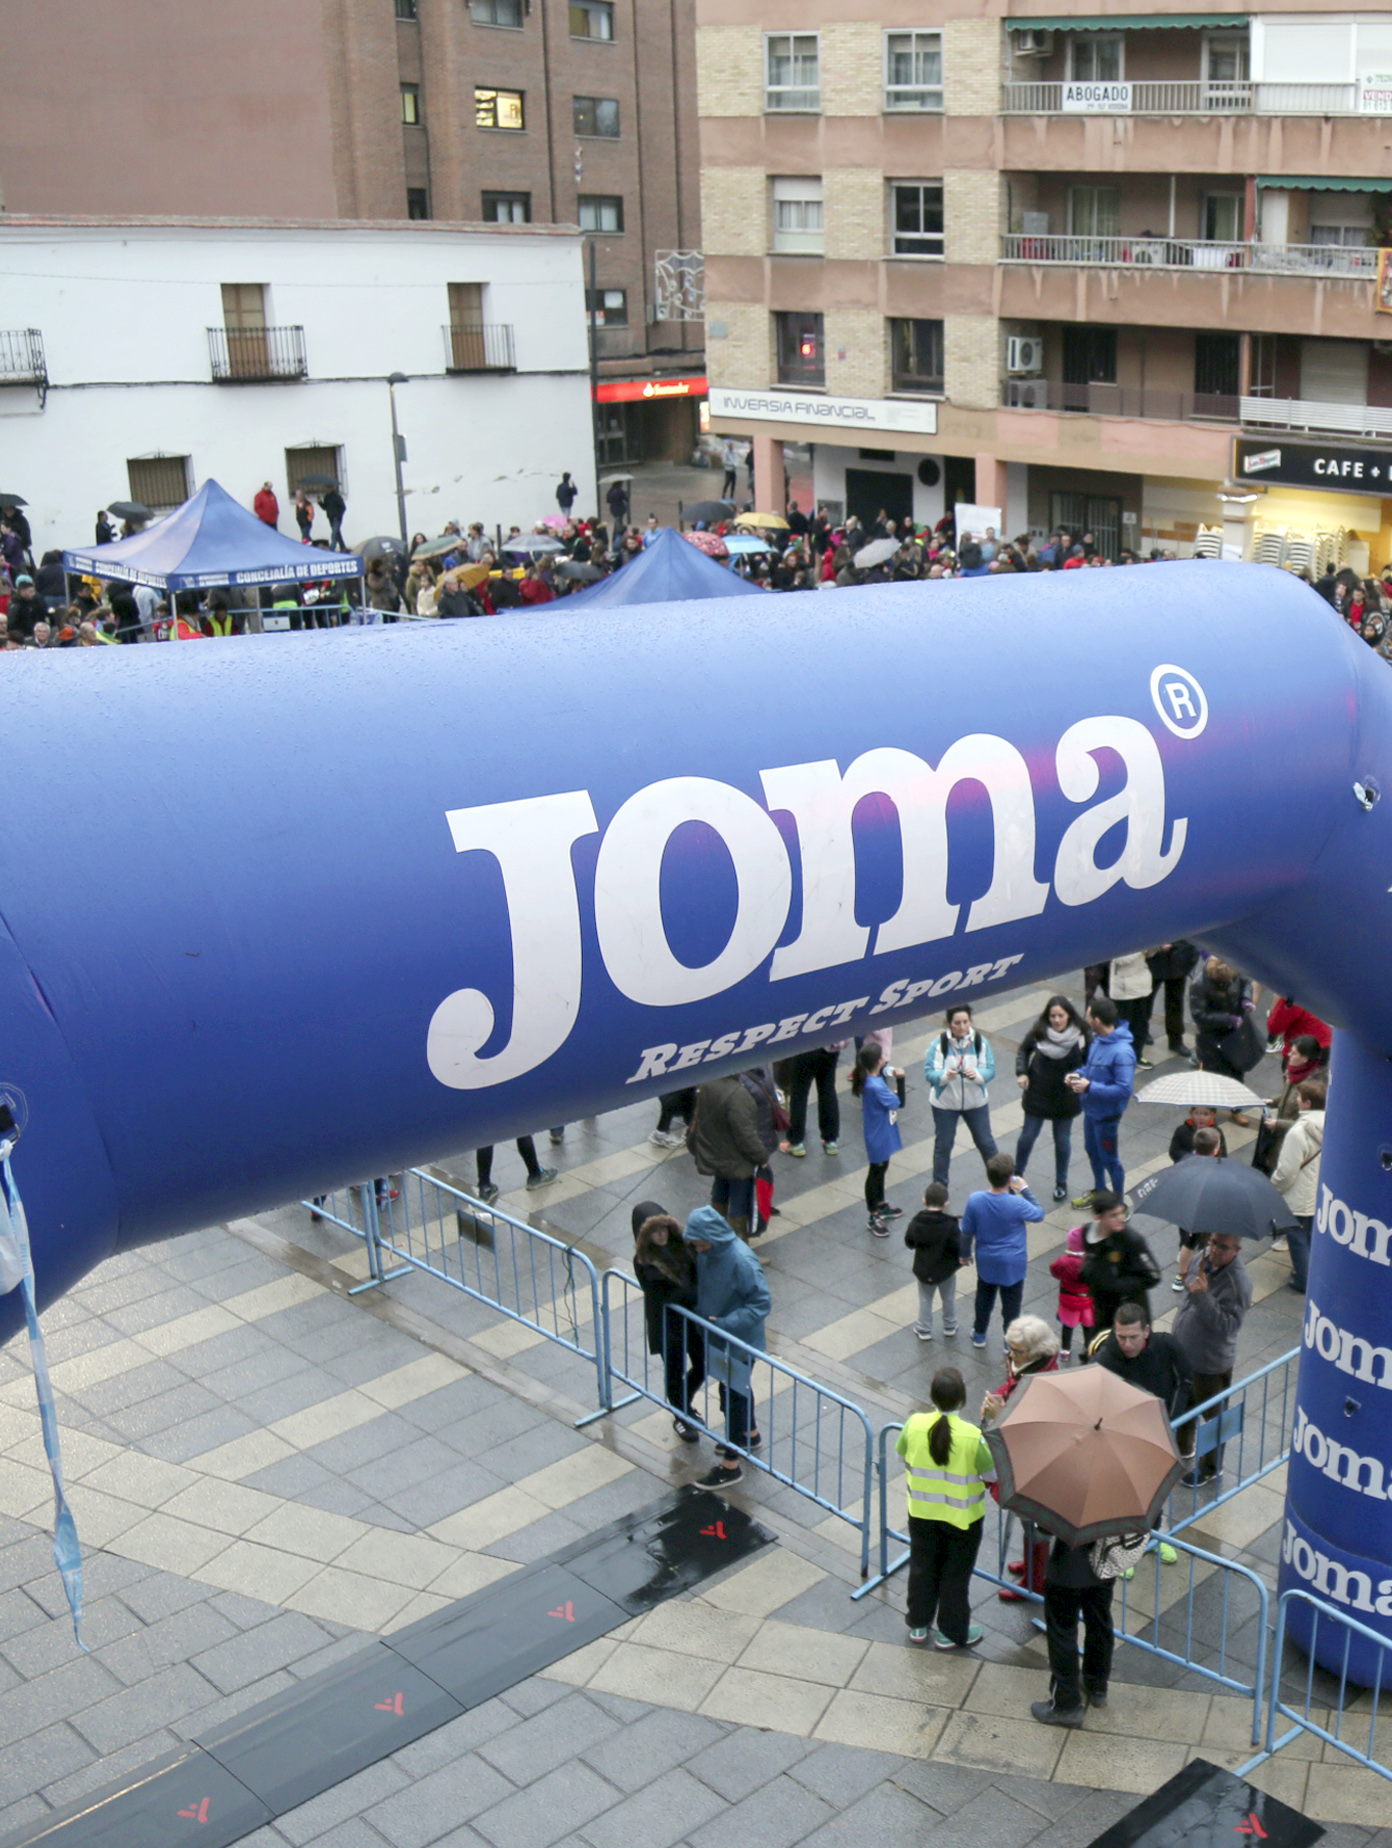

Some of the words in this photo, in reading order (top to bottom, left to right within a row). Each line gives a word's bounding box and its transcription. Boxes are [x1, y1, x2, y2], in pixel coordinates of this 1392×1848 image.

[1067, 86, 1129, 101] ABOGADO
[654, 382, 689, 395] Santander
[724, 397, 793, 413] INVERSIA
[1313, 458, 1364, 478] CAFE
[296, 564, 309, 578] DE
[311, 560, 358, 576] DEPORTES
[625, 996, 870, 1084] RESPECT
[868, 953, 1024, 1016] SPORT
